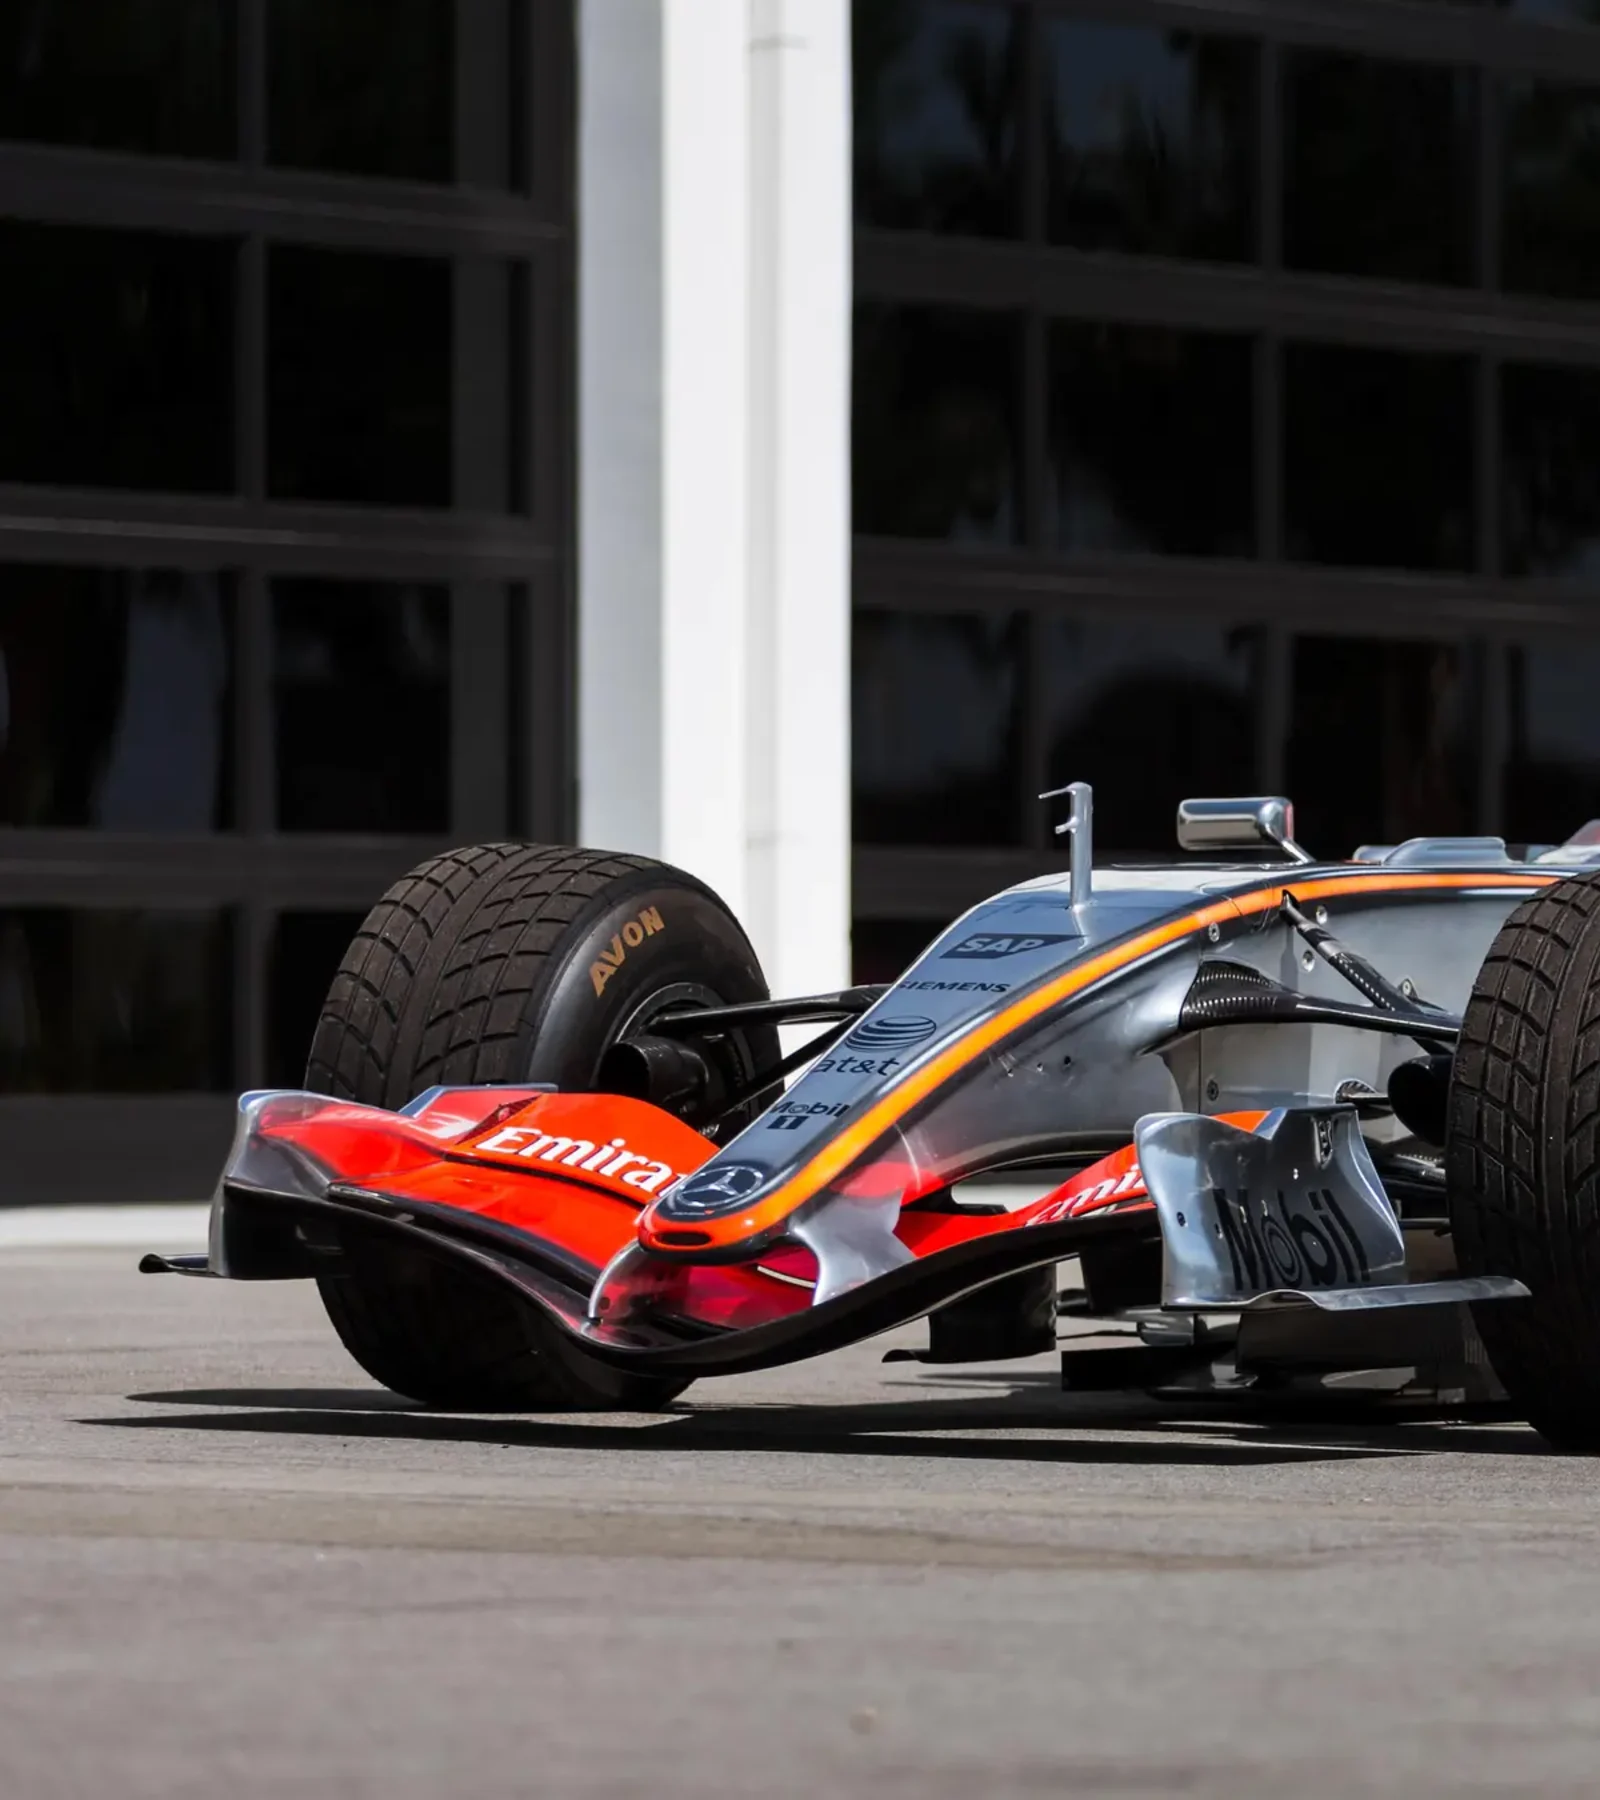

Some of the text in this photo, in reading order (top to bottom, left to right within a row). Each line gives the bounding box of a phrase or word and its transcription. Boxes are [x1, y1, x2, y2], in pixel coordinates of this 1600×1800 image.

[589, 905, 665, 998] AVON
[956, 938, 1044, 953] SAP
[899, 981, 1011, 993] SIEMENS
[813, 1056, 900, 1076] at&t
[769, 1101, 851, 1117] Mobil
[1212, 1188, 1371, 1291] Mobil
